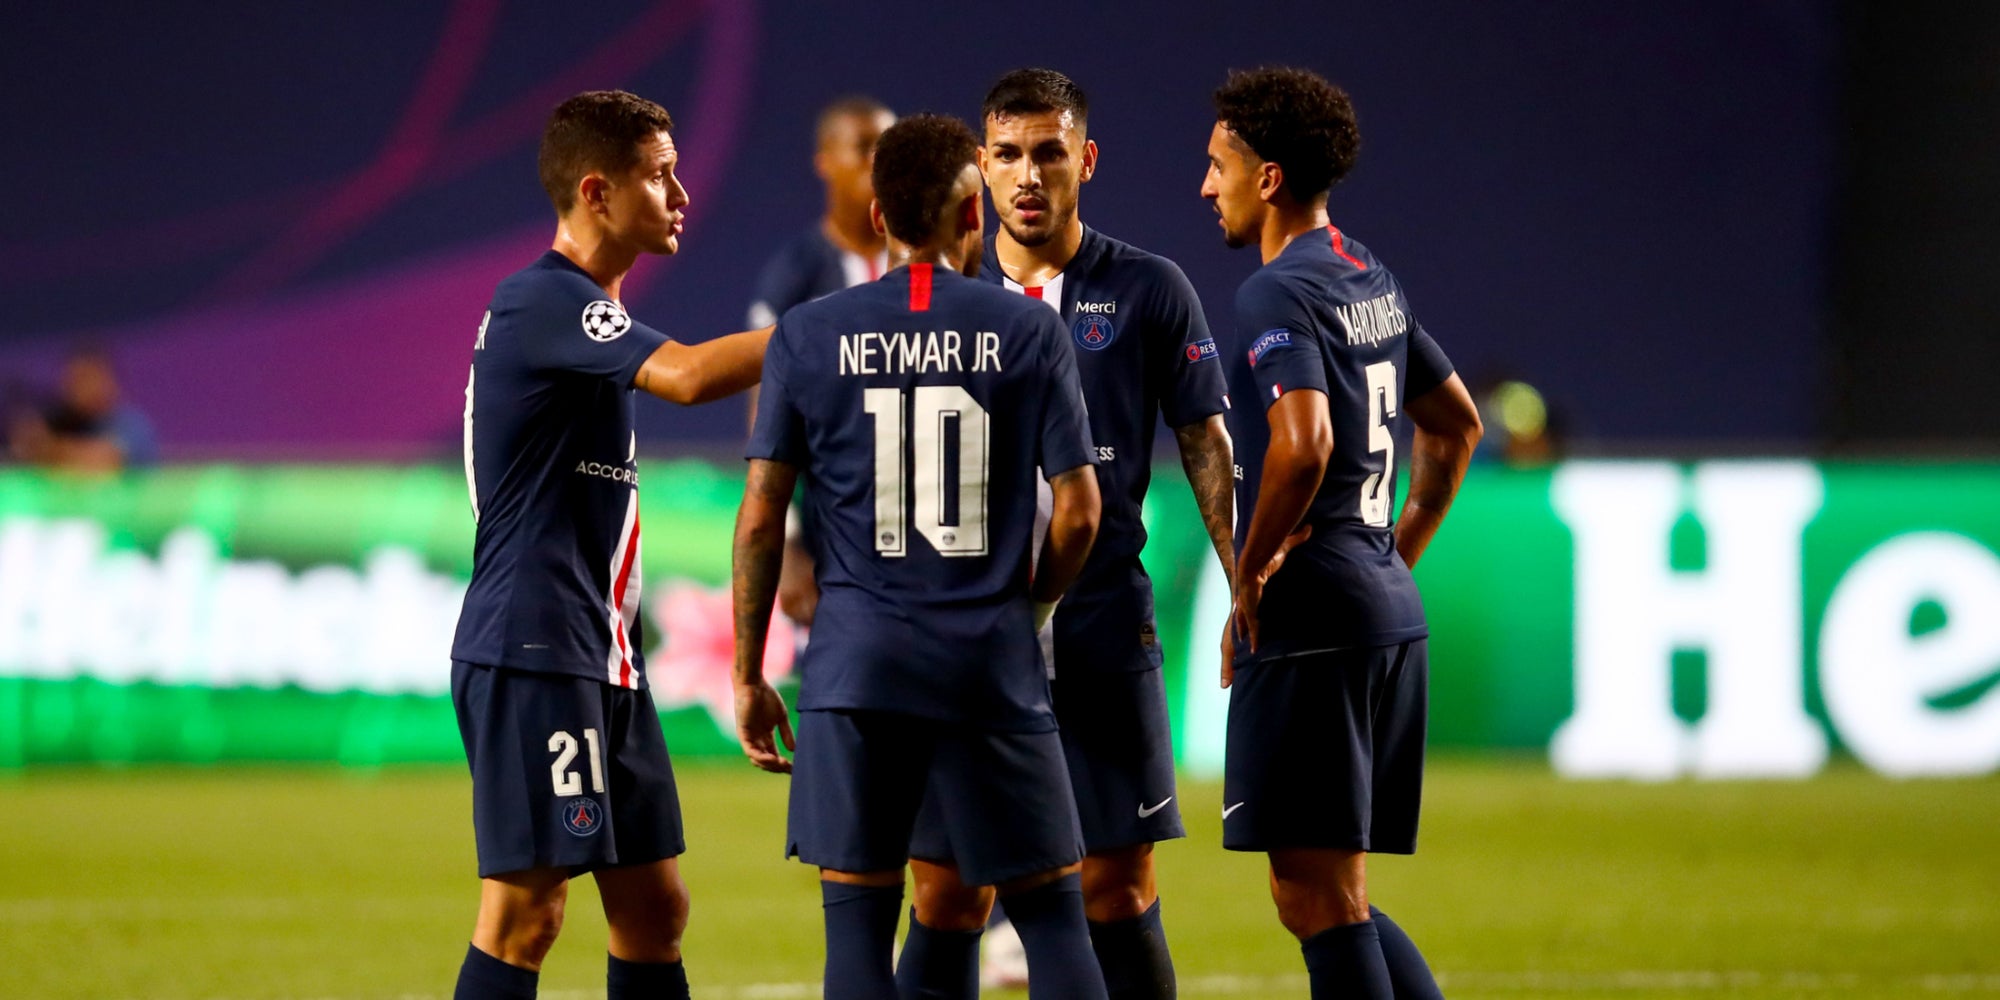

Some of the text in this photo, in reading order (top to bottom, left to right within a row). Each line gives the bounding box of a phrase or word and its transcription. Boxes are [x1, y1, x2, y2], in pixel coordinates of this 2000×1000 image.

[1076, 301, 1116, 314] Merci
[839, 331, 1002, 375] NEYMAR JR
[1254, 333, 1290, 356] RESPECT
[864, 386, 990, 557] 10
[1360, 361, 1397, 528] 5
[1548, 459, 2000, 780] He
[548, 728, 605, 797] 21
